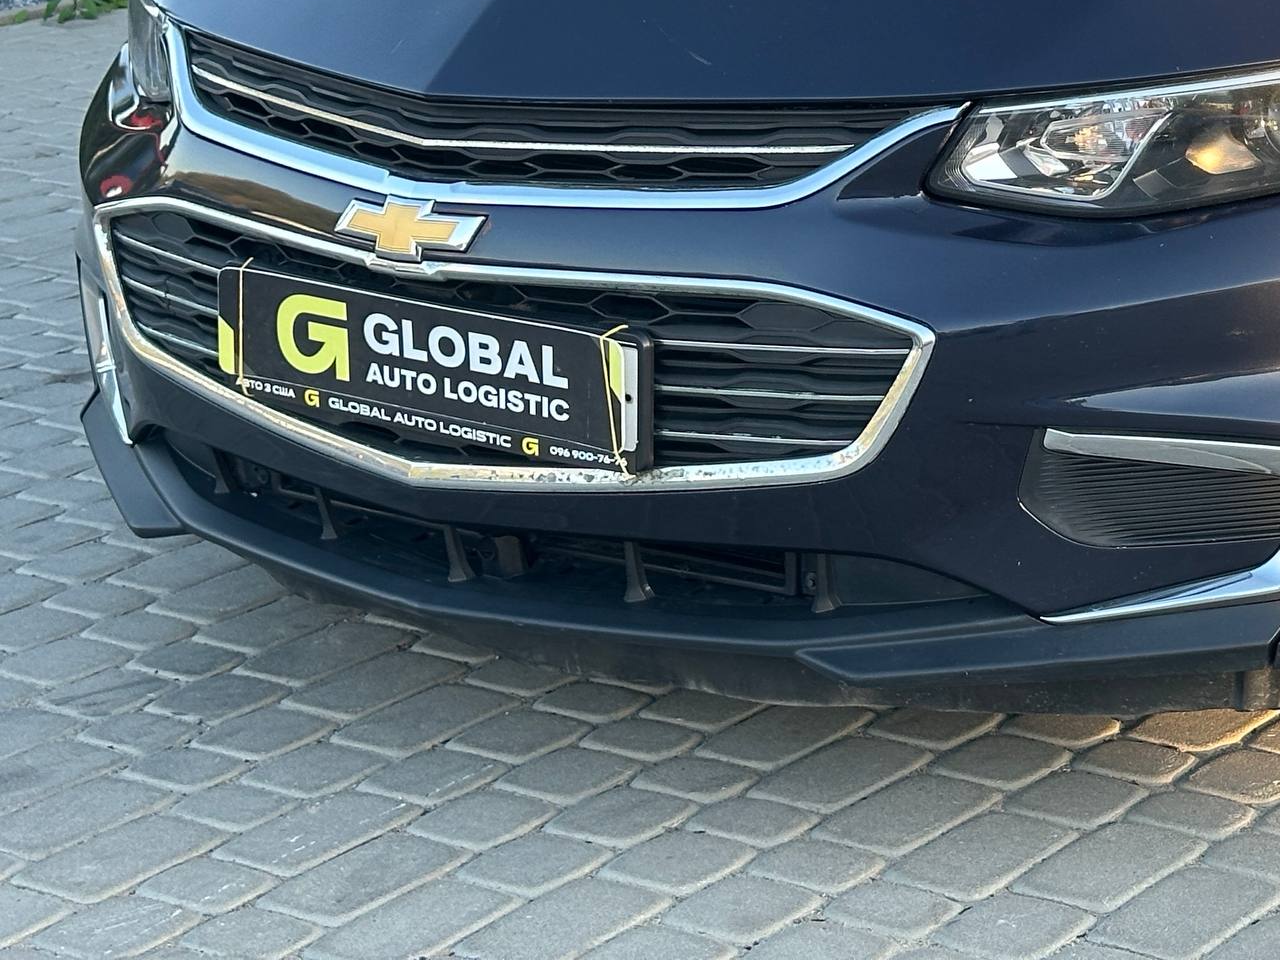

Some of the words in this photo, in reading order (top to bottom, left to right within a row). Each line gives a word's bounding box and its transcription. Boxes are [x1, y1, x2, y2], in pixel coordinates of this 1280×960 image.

[363, 313, 570, 389] GLOBAL
[272, 385, 296, 398] США
[365, 362, 437, 396] AUTO
[443, 381, 571, 422] LOGISTIC
[327, 396, 391, 422] GLOBAL
[393, 412, 437, 432] AUTO
[440, 421, 512, 448] LOGISTIC
[549, 446, 571, 458] 096
